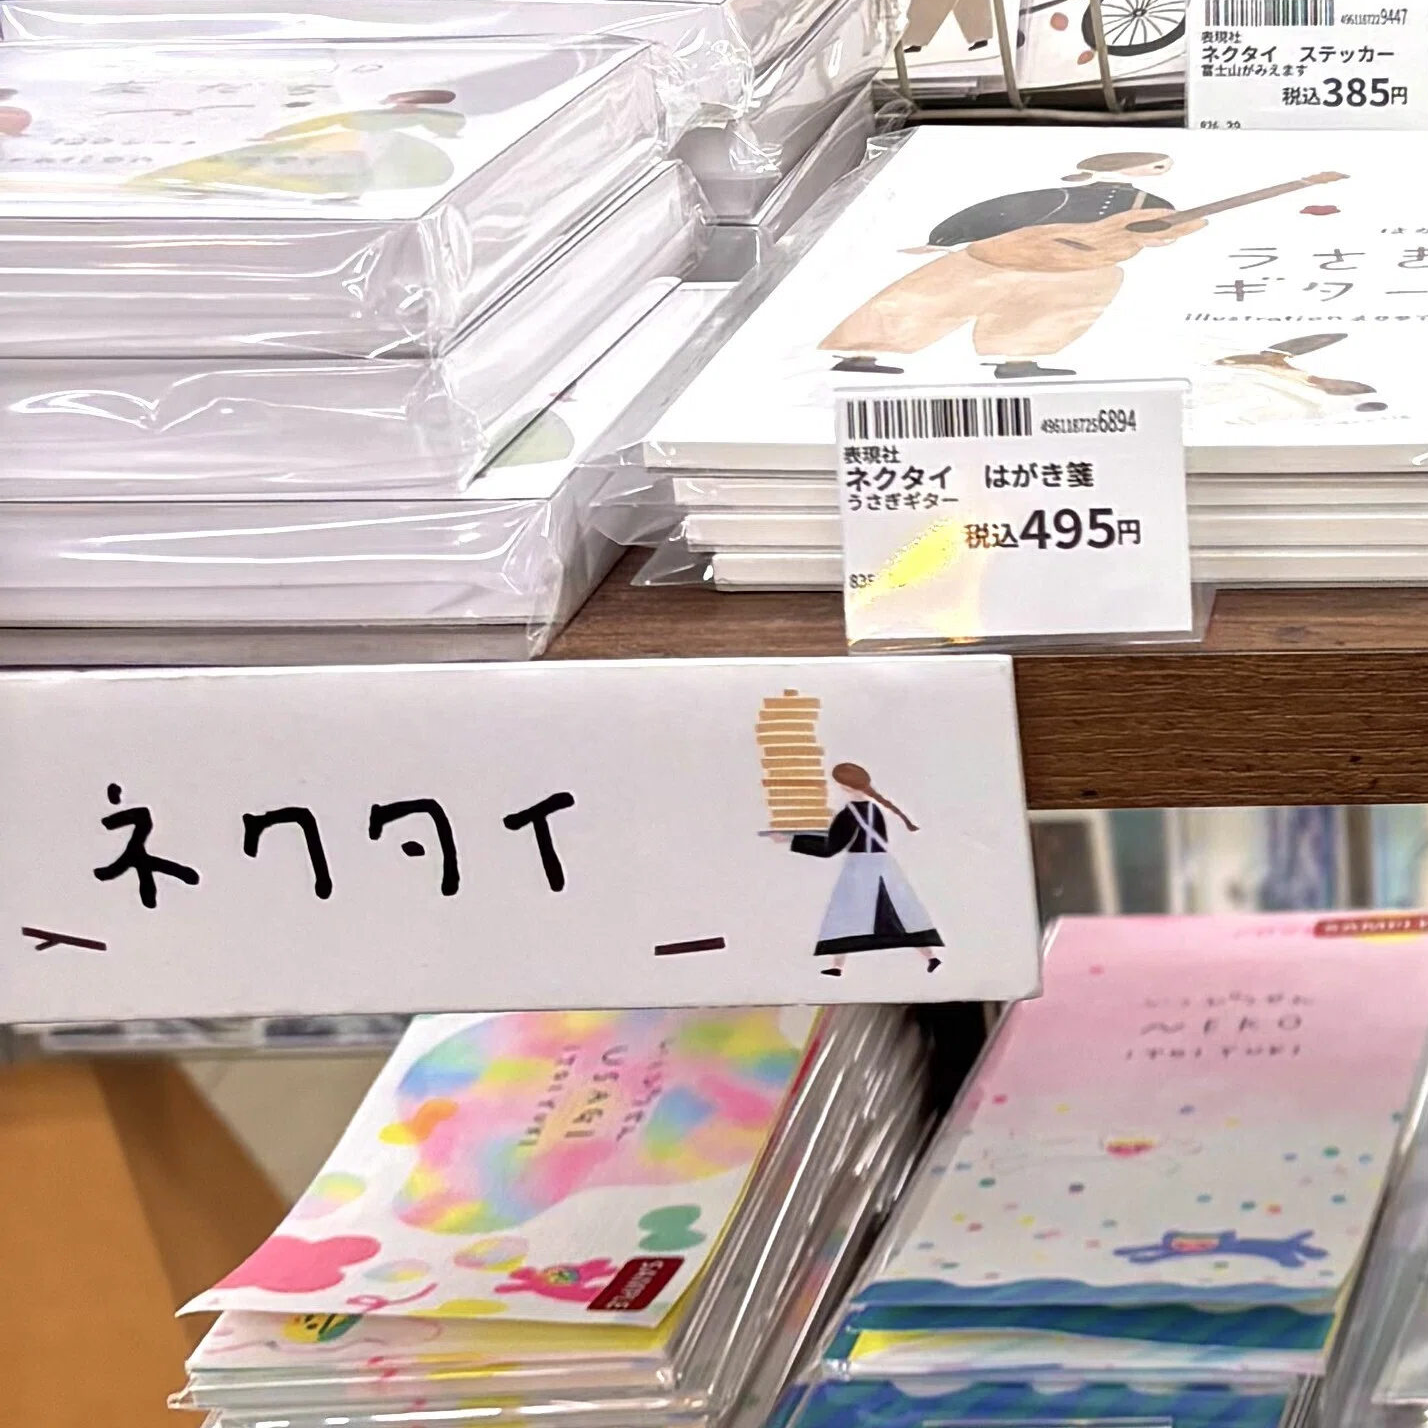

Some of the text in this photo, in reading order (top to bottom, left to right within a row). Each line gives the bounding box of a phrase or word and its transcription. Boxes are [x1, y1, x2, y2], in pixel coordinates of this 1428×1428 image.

[1201, 31, 1242, 44] 表現社
[1201, 46, 1395, 63] ネクタイ ステッカー
[1201, 64, 1308, 77] 富士山がみえます
[1281, 78, 1408, 107] 税込385円
[1213, 277, 1428, 302] ギター
[844, 445, 901, 464] 表現社
[846, 462, 1095, 492] ネクタイ はがき箋
[848, 493, 959, 511] うさぎギター
[963, 508, 1142, 550] 税込495円
[92, 783, 574, 908] ネクタイ
